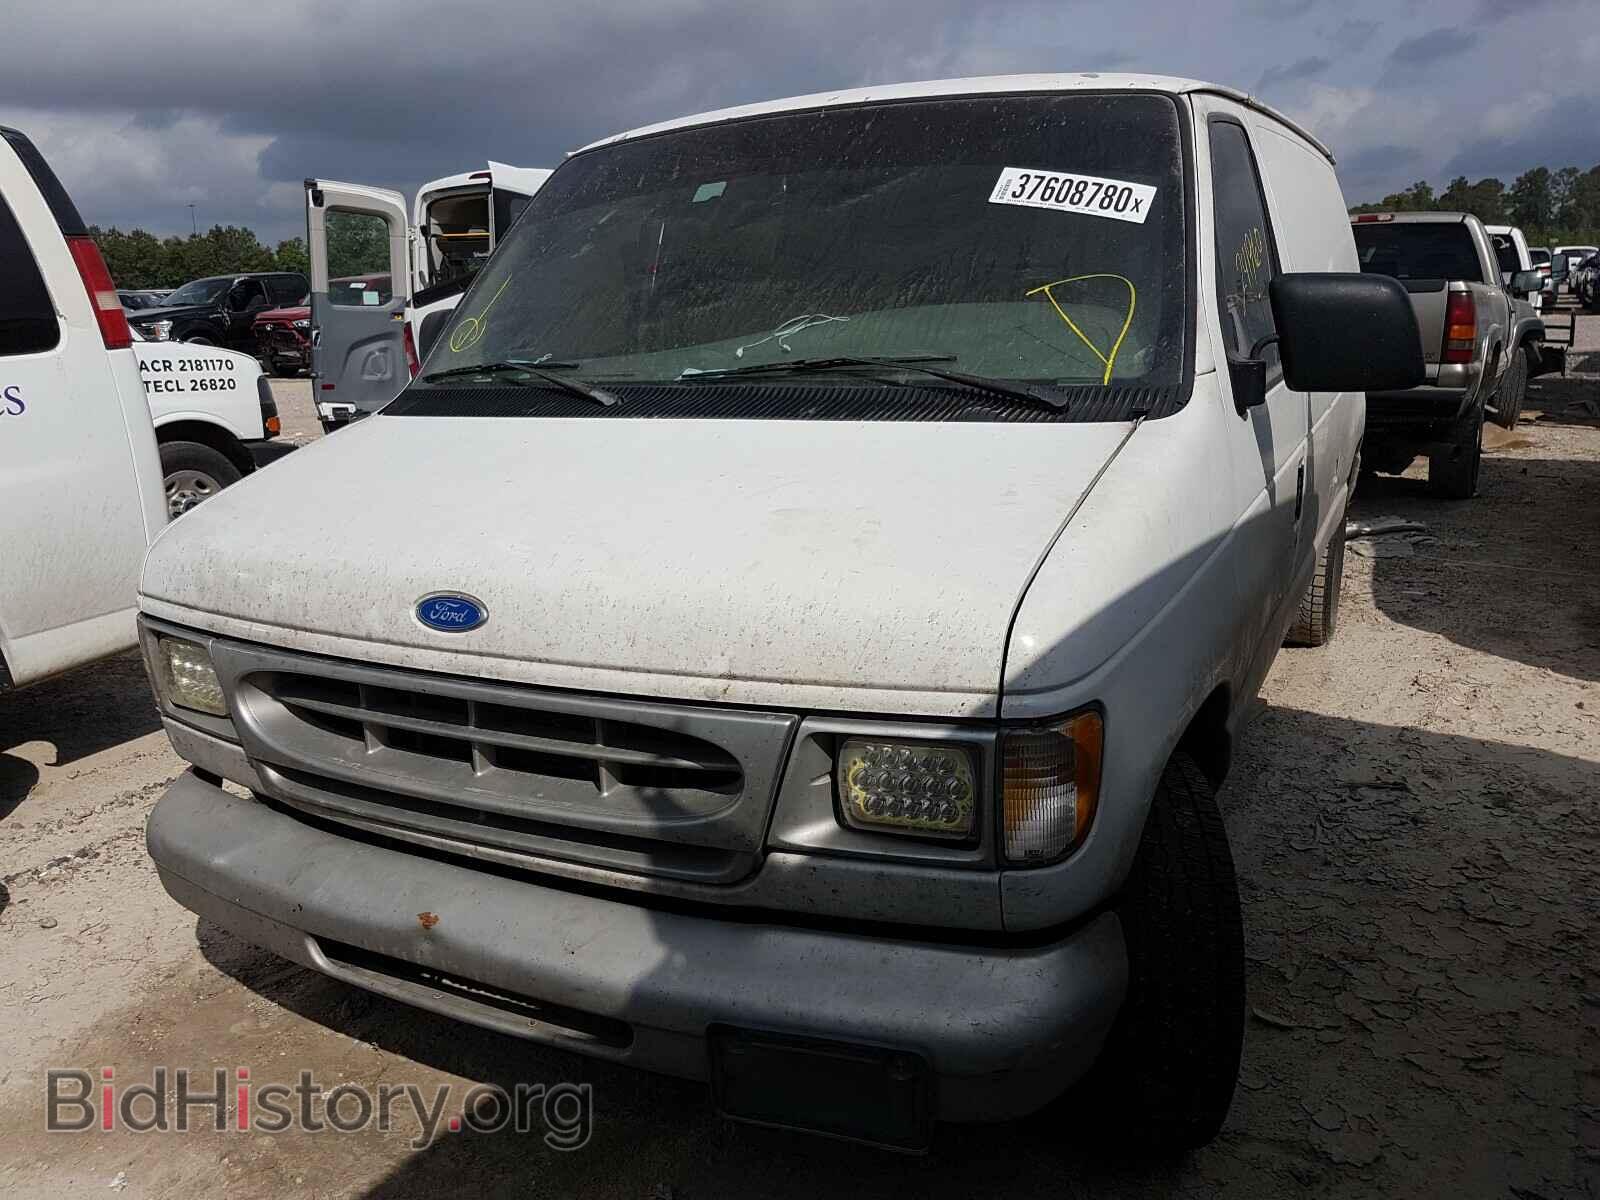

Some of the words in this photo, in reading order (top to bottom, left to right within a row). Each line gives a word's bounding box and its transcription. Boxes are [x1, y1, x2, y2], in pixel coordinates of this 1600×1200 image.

[179, 359, 234, 372] 2181170
[143, 379, 185, 393] TECL
[190, 378, 236, 392] 26820
[430, 601, 469, 623] Ford
